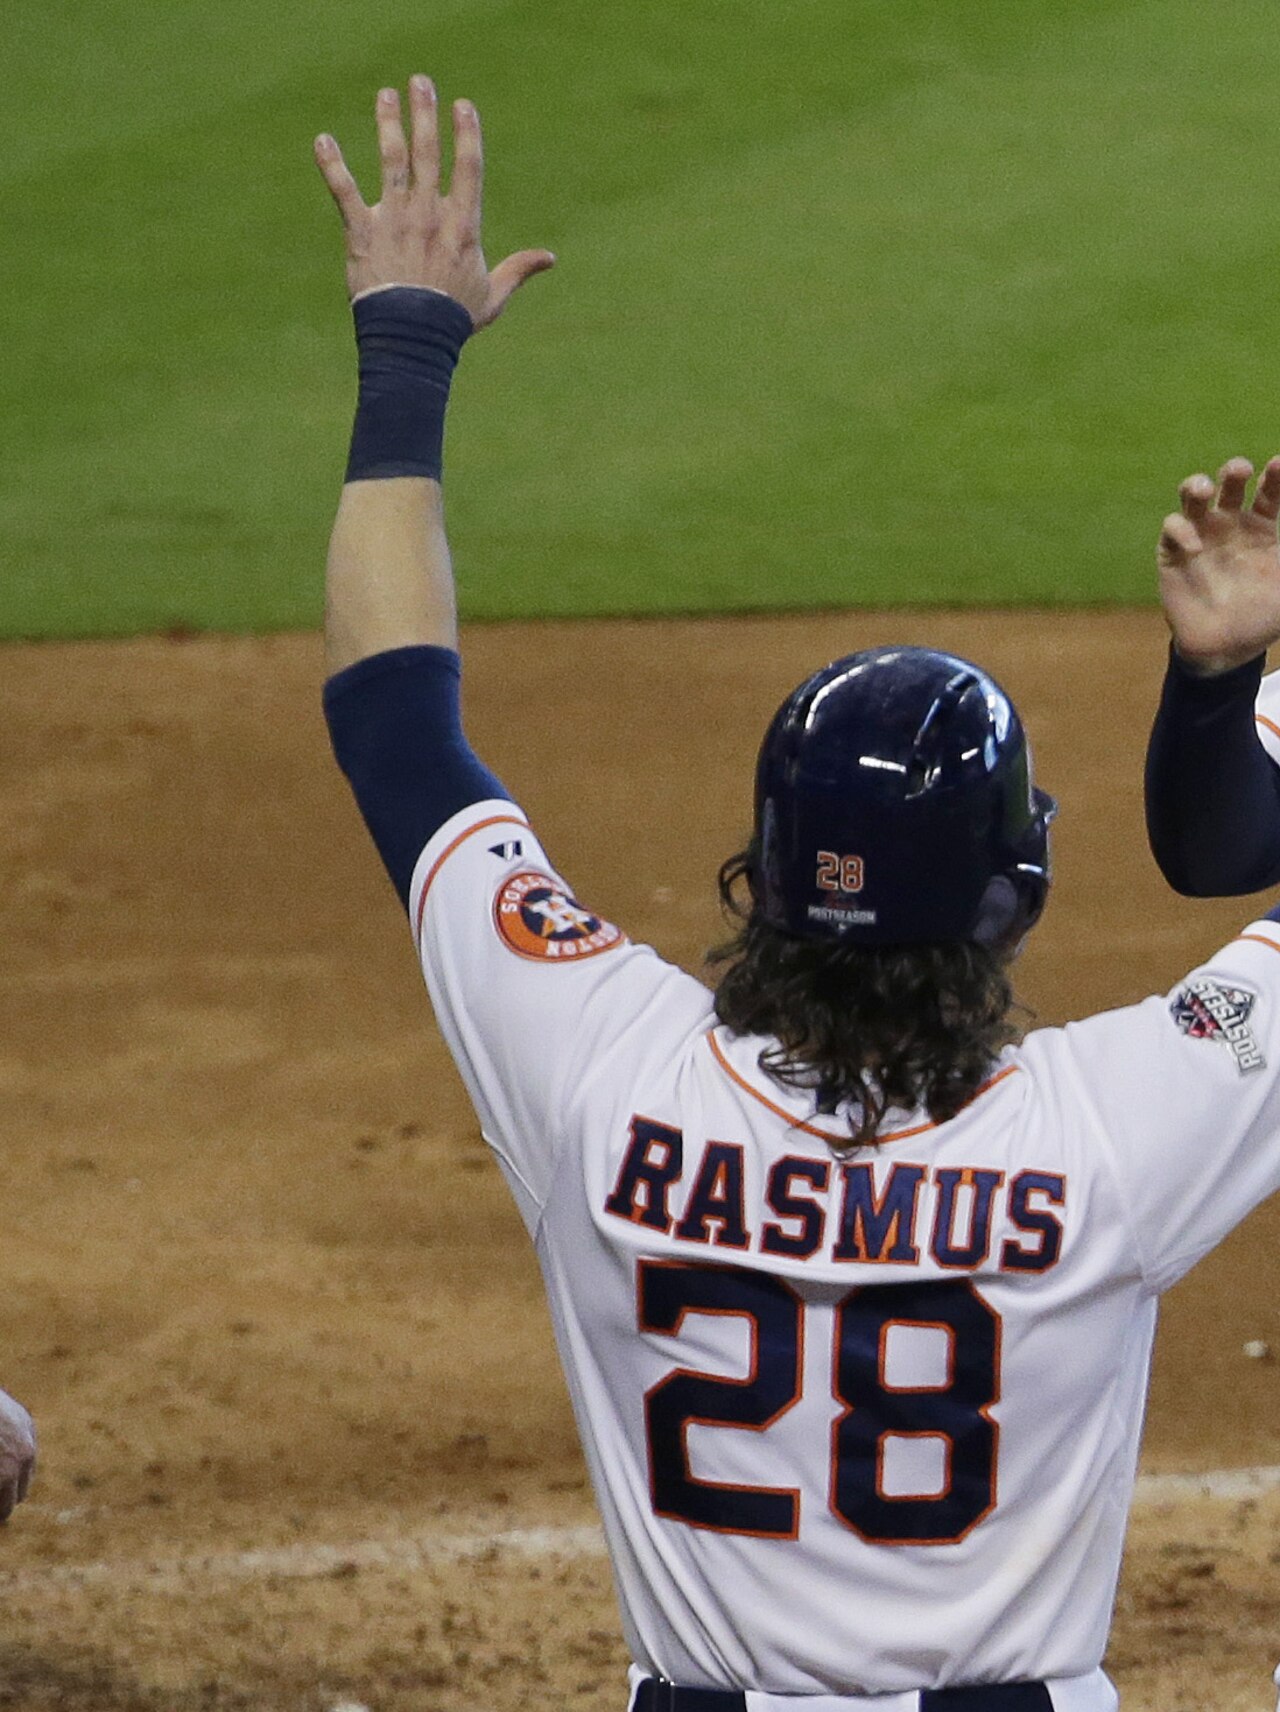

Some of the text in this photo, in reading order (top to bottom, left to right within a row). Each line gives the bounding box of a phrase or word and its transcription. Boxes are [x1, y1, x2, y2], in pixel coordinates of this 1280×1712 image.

[816, 850, 864, 893] 28
[604, 1114, 1067, 1273] RASMUS
[636, 1257, 1003, 1546] 28
